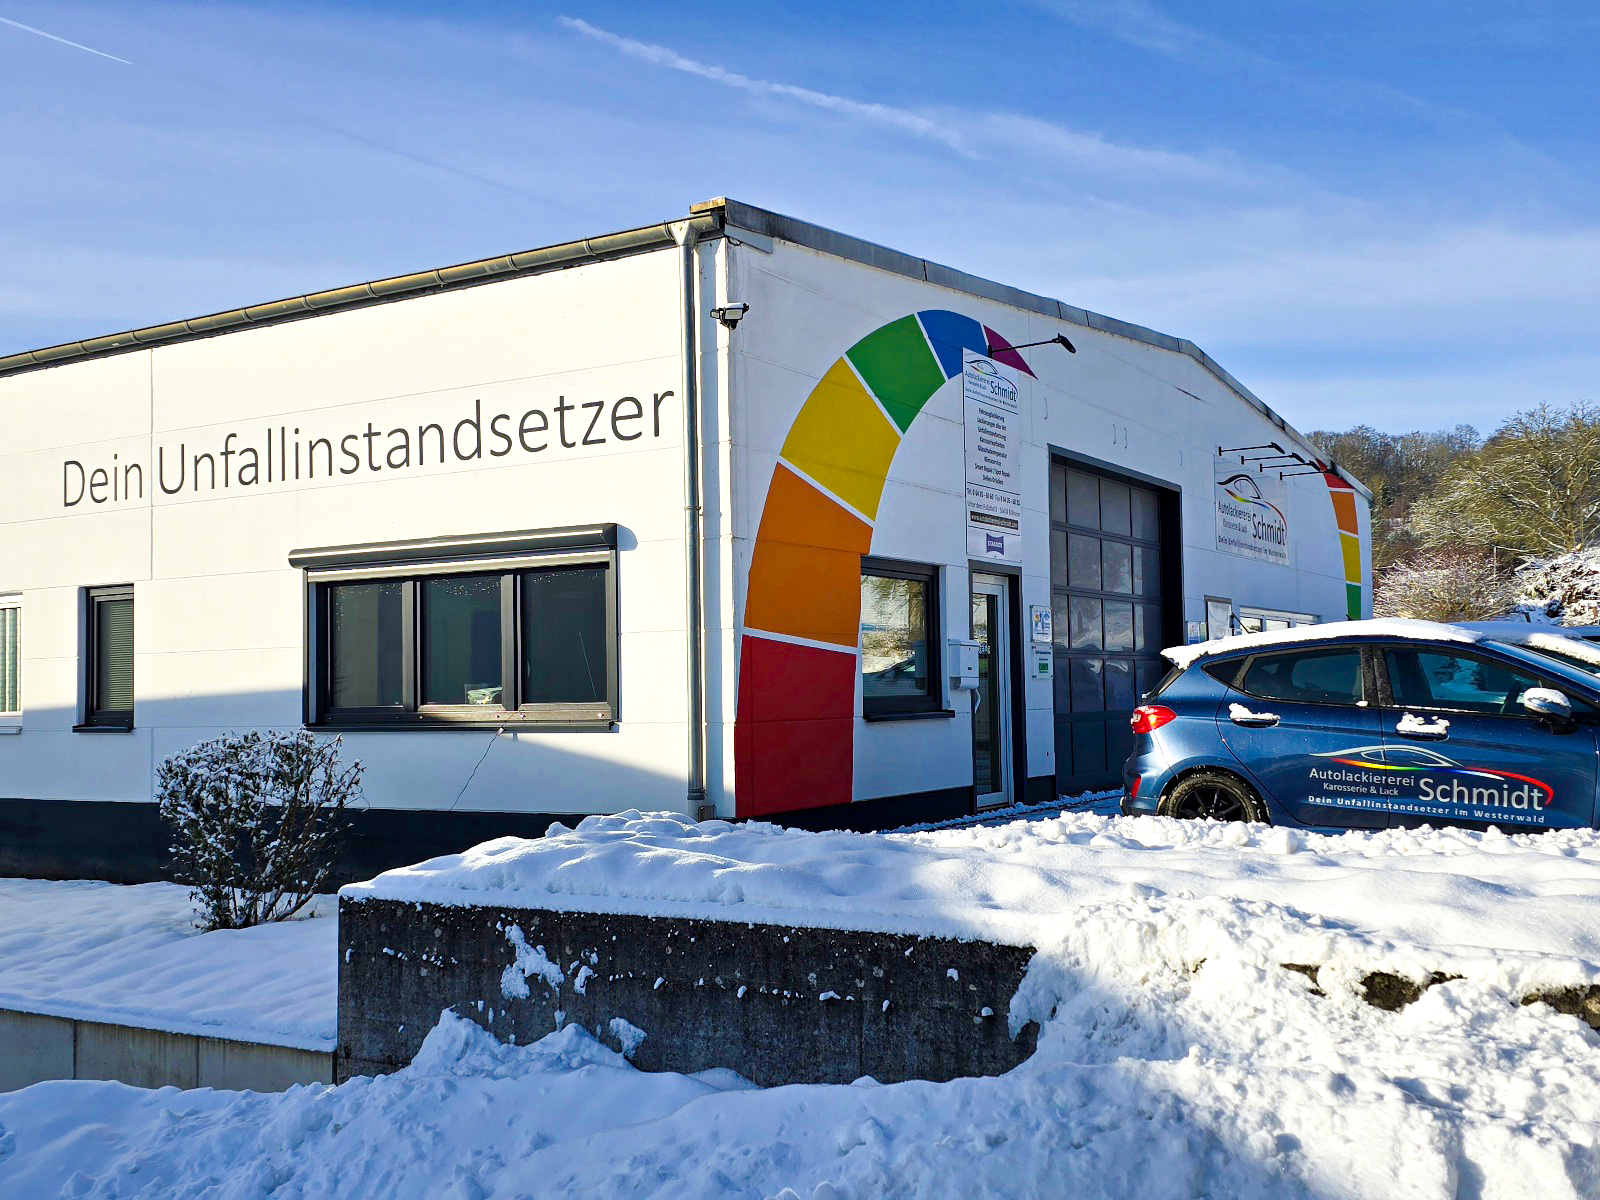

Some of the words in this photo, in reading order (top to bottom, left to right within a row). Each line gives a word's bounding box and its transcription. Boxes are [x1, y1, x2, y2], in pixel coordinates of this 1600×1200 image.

[990, 380, 1016, 402] Schmidt
[63, 453, 143, 508] Dein
[158, 390, 675, 495] Unfallinstandsetzer
[1218, 500, 1252, 522] Autolackiererei
[1252, 512, 1286, 546] Schmidt
[1309, 767, 1415, 787] Autolackiererei
[1323, 782, 1368, 794] Karosserie
[1370, 786, 1378, 795] &
[1380, 786, 1400, 796] Lack
[1418, 777, 1544, 811] Schmidt
[1308, 795, 1332, 804] Dein
[1337, 798, 1450, 815] Unfallinstandsetzer
[1454, 807, 1468, 816] im
[1473, 809, 1545, 823] Westerwald
